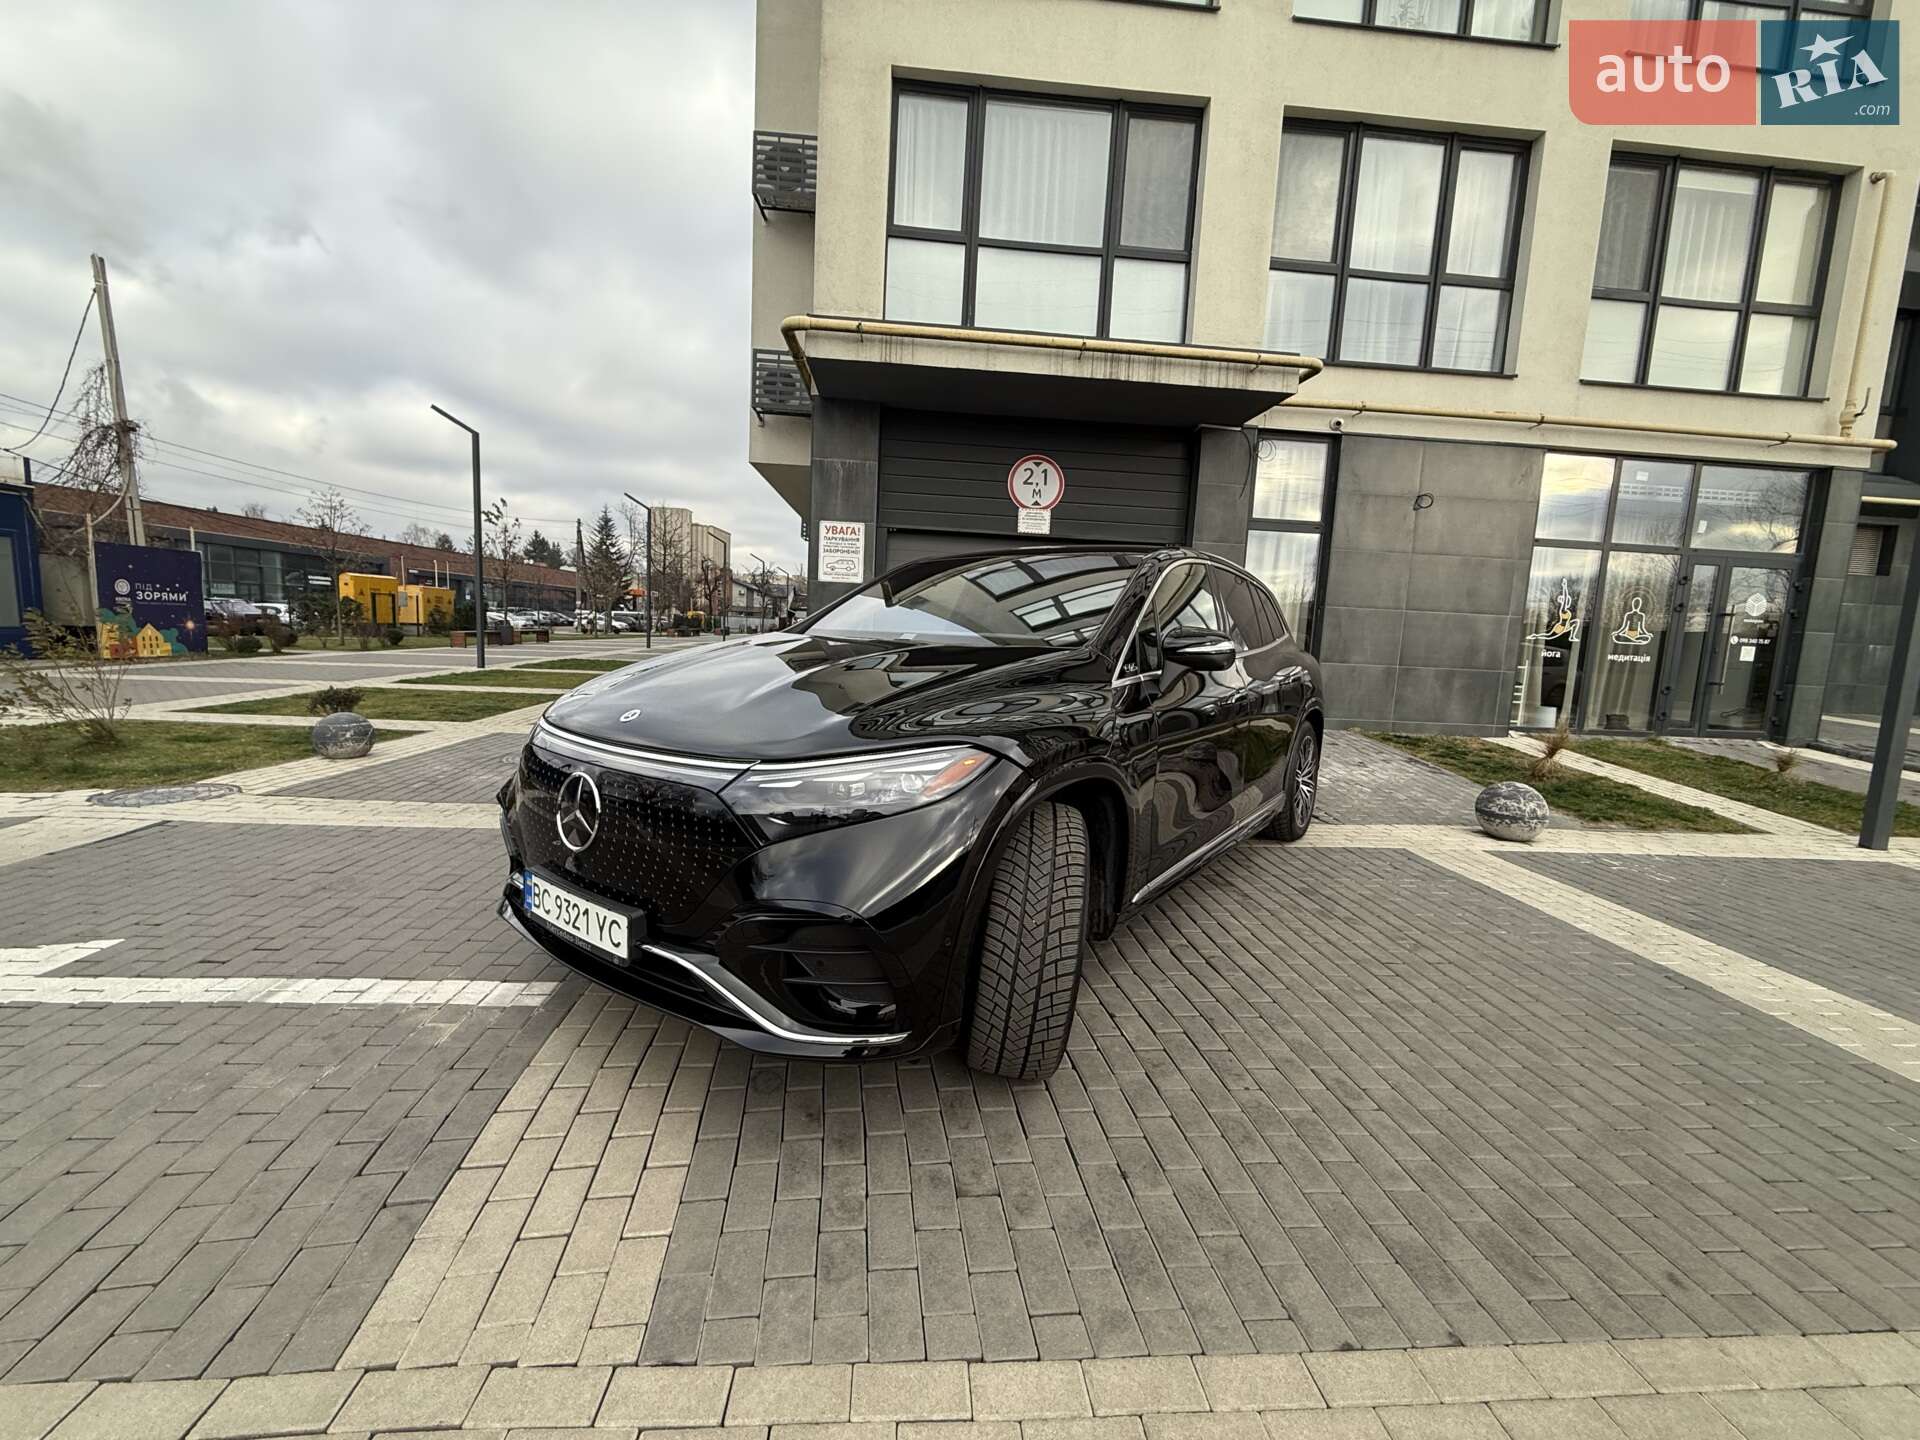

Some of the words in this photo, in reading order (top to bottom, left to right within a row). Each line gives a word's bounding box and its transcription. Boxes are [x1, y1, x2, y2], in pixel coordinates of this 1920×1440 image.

[1023, 467, 1048, 487] 2,1
[825, 525, 861, 536] УВАГА!
[135, 582, 153, 591] ПІД
[136, 591, 187, 602] ЗОРЯМИ
[1541, 649, 1561, 658] йога
[1607, 653, 1651, 663] медитація
[533, 882, 551, 915] BC
[555, 895, 590, 935] 9321
[596, 911, 622, 949] YC
